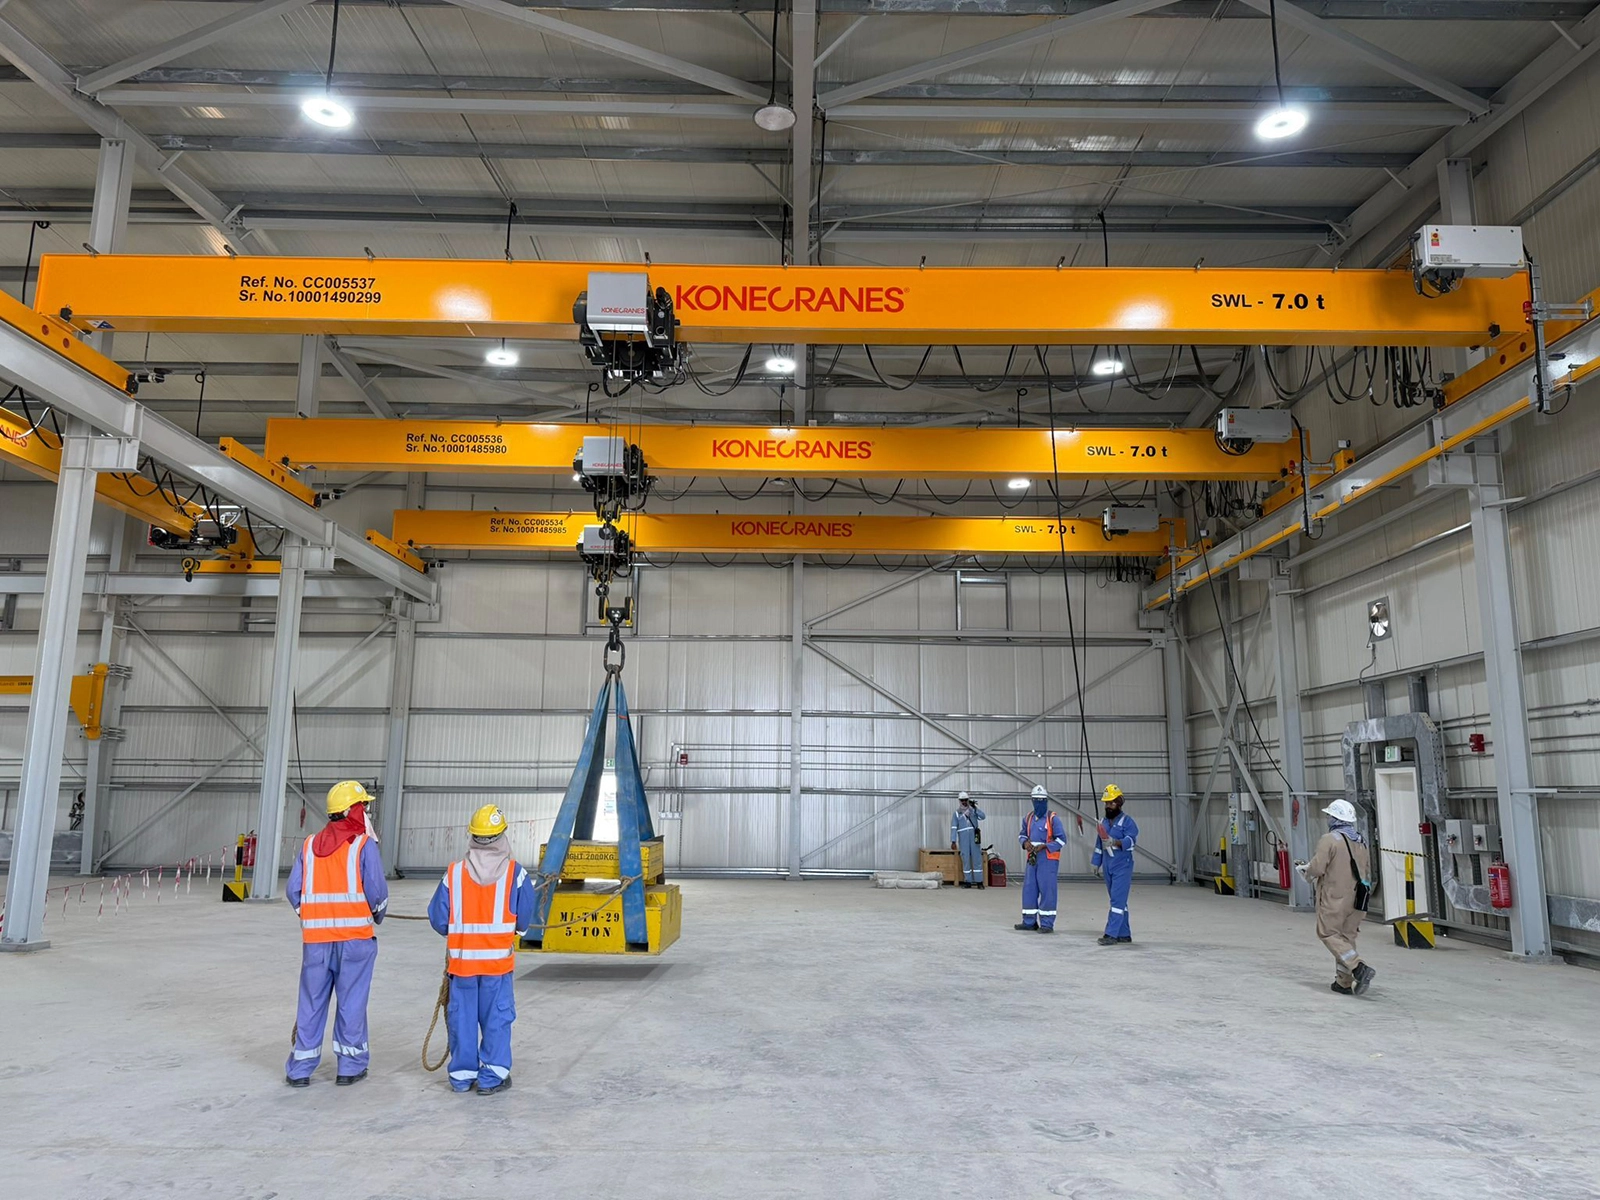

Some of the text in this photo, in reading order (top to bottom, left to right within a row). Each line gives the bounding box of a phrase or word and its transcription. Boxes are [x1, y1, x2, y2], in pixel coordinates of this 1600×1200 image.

[240, 275, 376, 289] Ref. No. CC005537
[239, 289, 258, 302] Sr.
[1211, 293, 1252, 308] SWL
[1272, 293, 1309, 310] 7.0
[1315, 294, 1325, 310] t
[406, 433, 503, 444] Ref. No. CC005536
[405, 443, 420, 453] Sr.
[1087, 445, 1116, 456] SWL
[1130, 445, 1156, 457] 7.0
[1161, 446, 1168, 457] t
[490, 517, 564, 526] Ref. No. CC005534
[1014, 525, 1037, 534] SWL
[1047, 525, 1067, 535] 7.0
[1070, 525, 1076, 535] t
[565, 926, 612, 938] 5-TON
